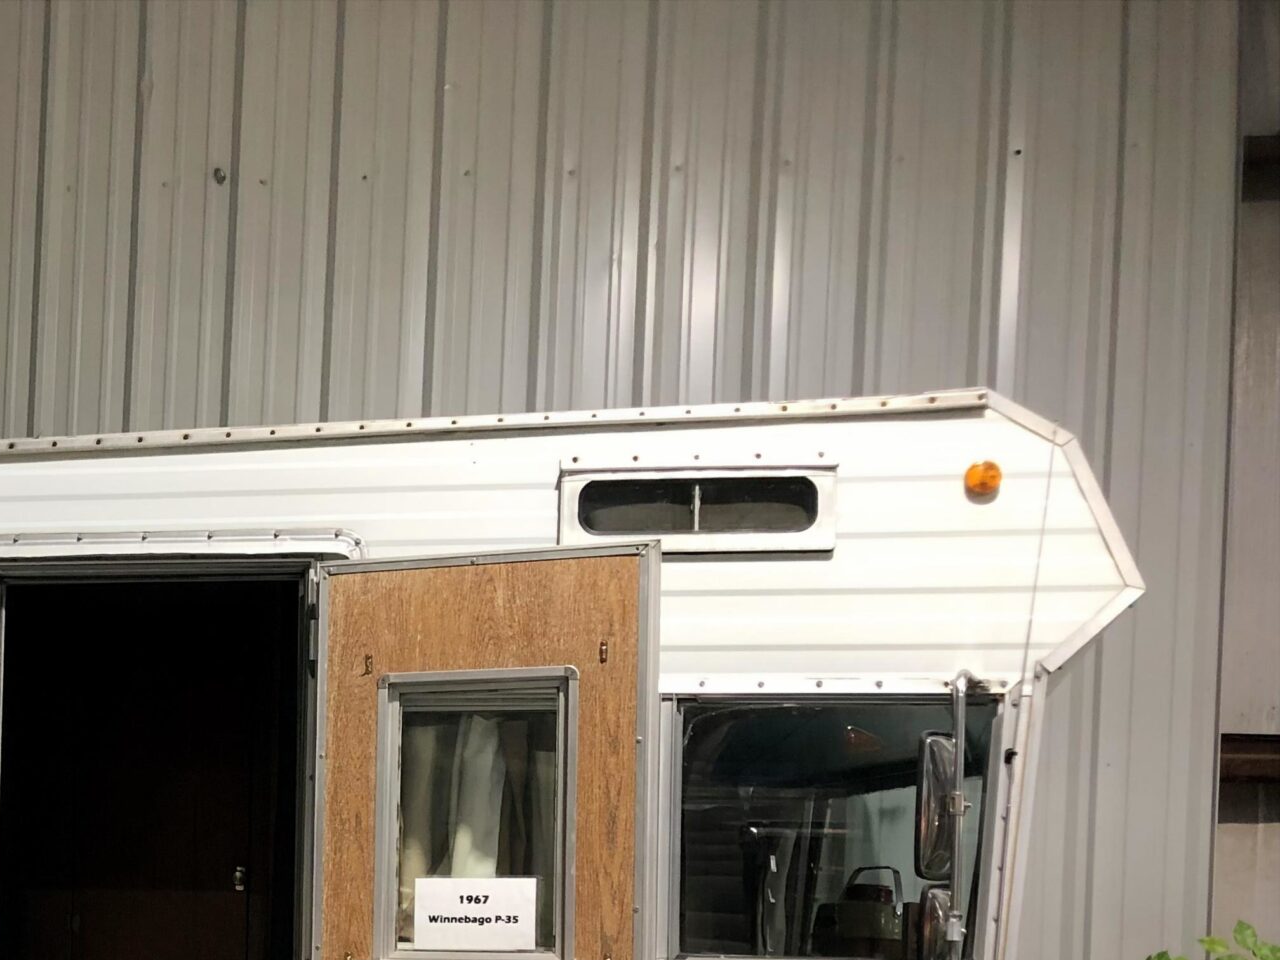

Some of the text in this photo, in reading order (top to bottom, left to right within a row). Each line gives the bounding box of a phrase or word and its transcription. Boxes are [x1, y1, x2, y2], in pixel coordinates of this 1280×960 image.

[459, 895, 489, 904] 1967
[428, 914, 519, 926] Winnebago P-35
